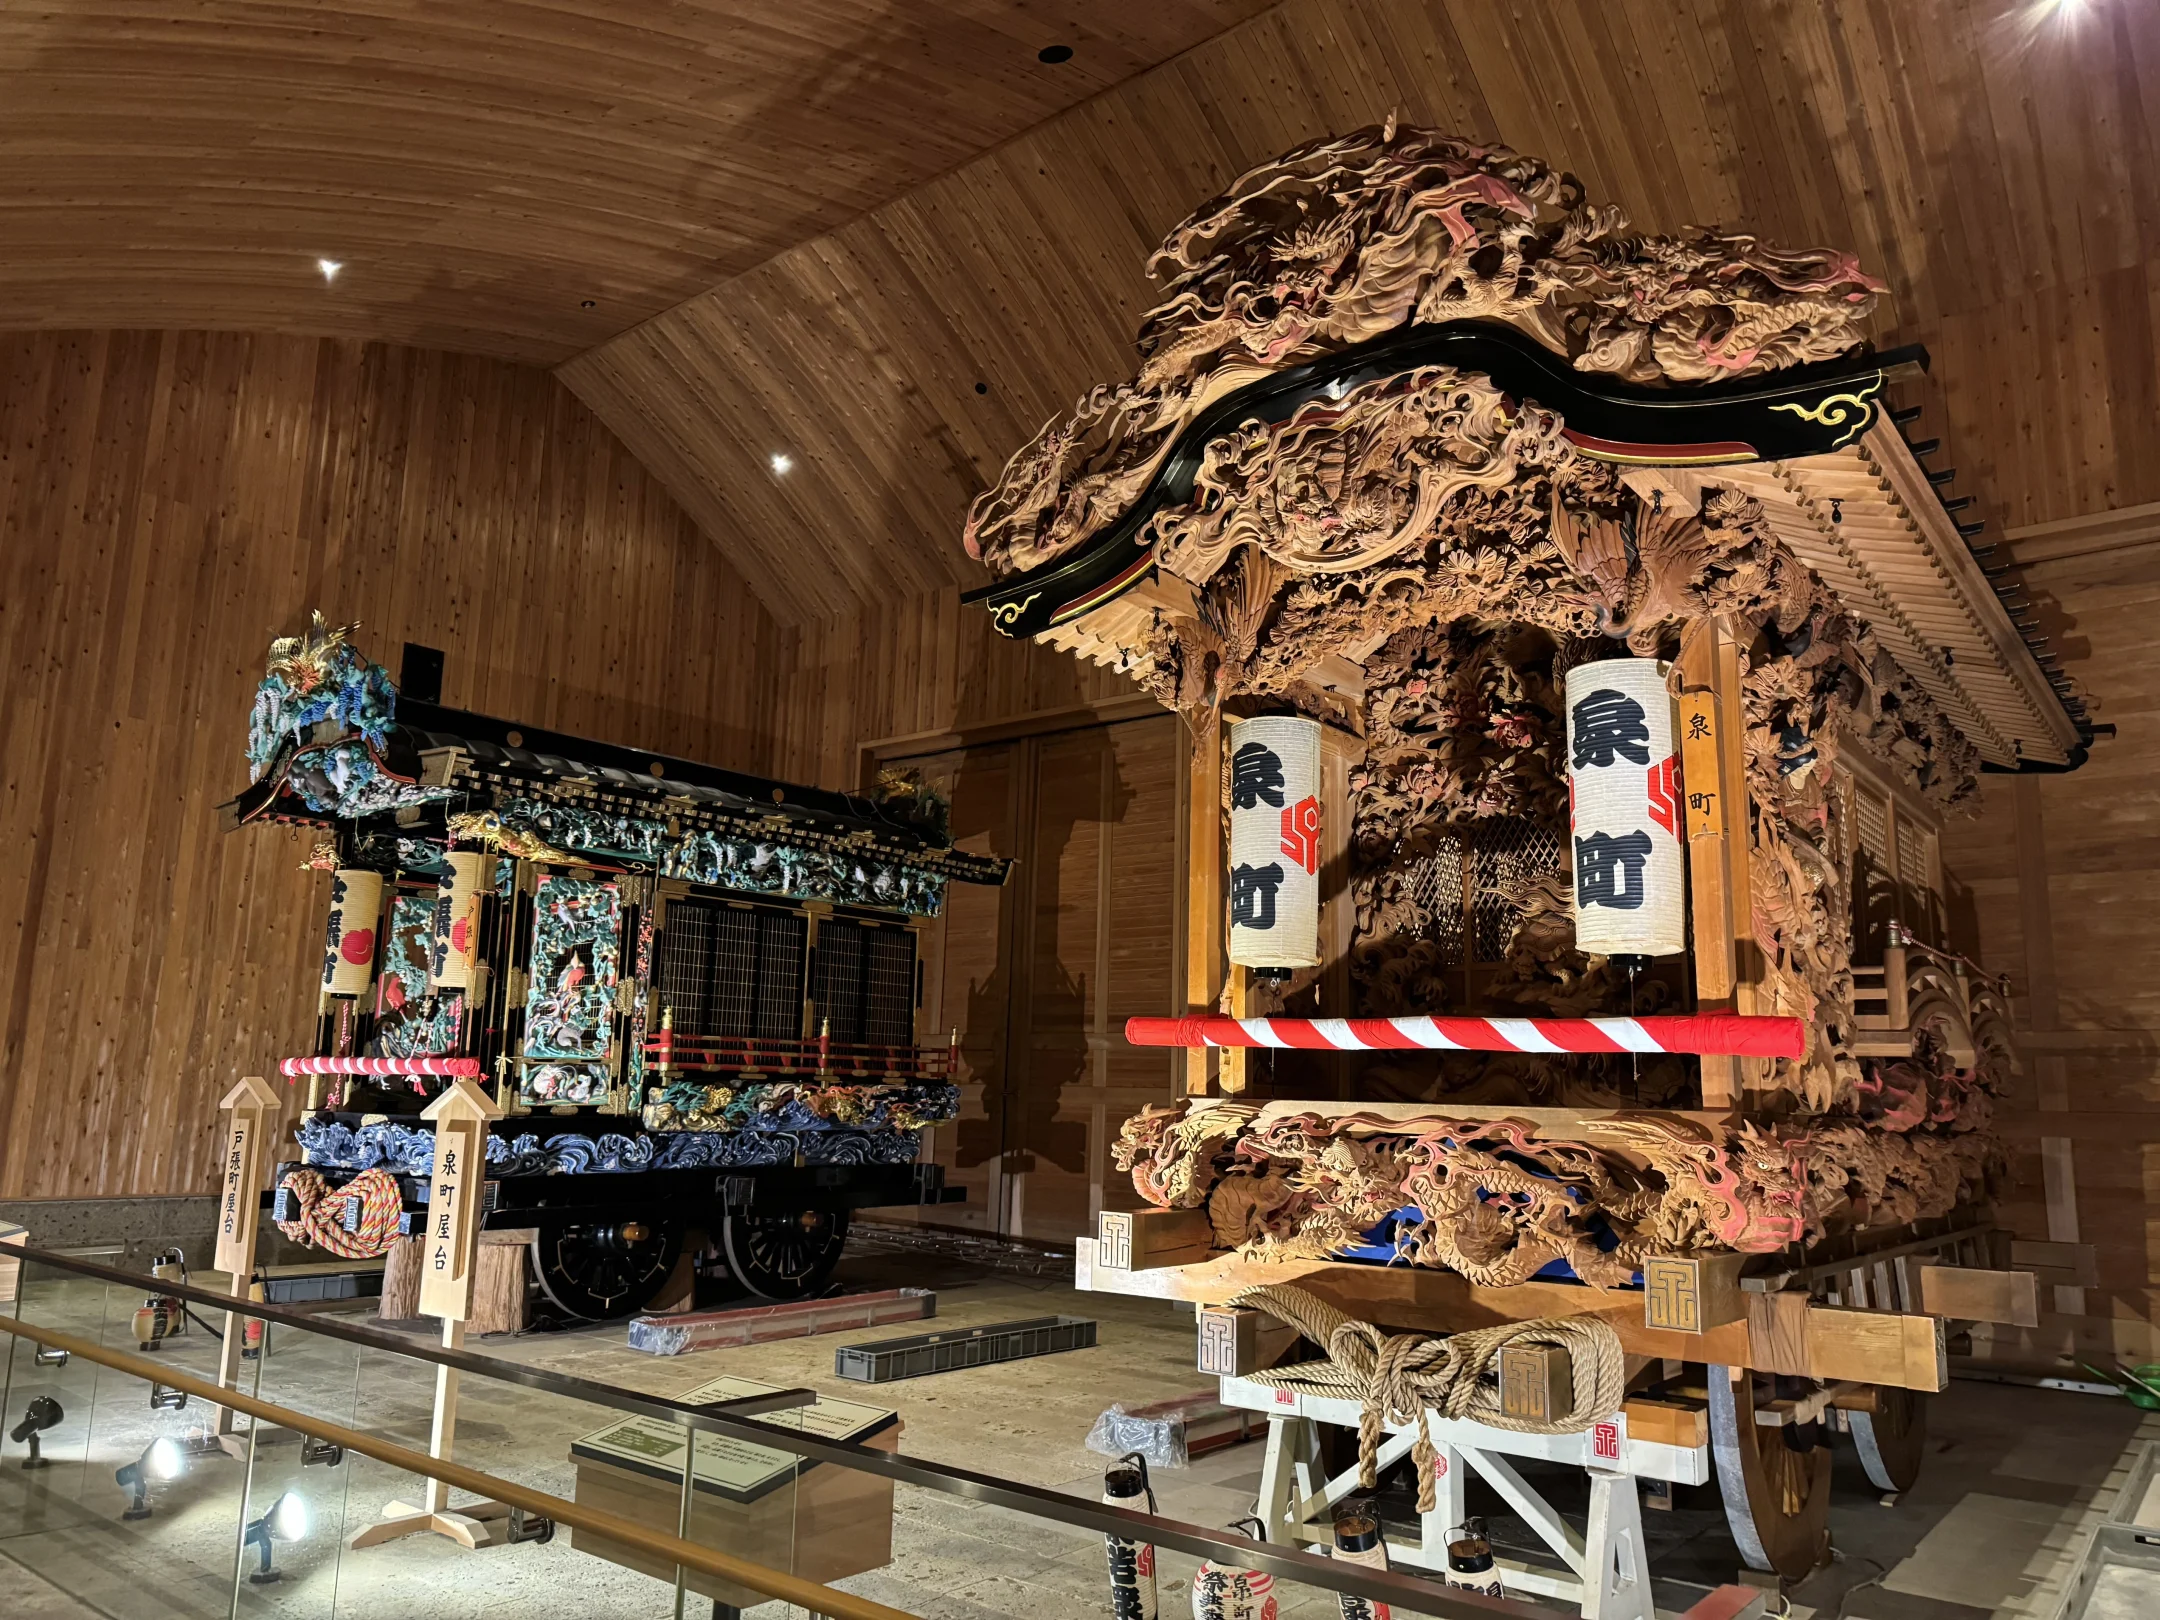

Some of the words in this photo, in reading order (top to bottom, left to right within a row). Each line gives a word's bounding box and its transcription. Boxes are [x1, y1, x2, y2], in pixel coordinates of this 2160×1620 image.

[1572, 689, 1652, 909] 泉町
[1687, 712, 1716, 815] 泉町
[1232, 742, 1285, 930] 泉町
[224, 1130, 244, 1233] 戸張町屋台
[434, 1150, 457, 1270] 泉町屋台
